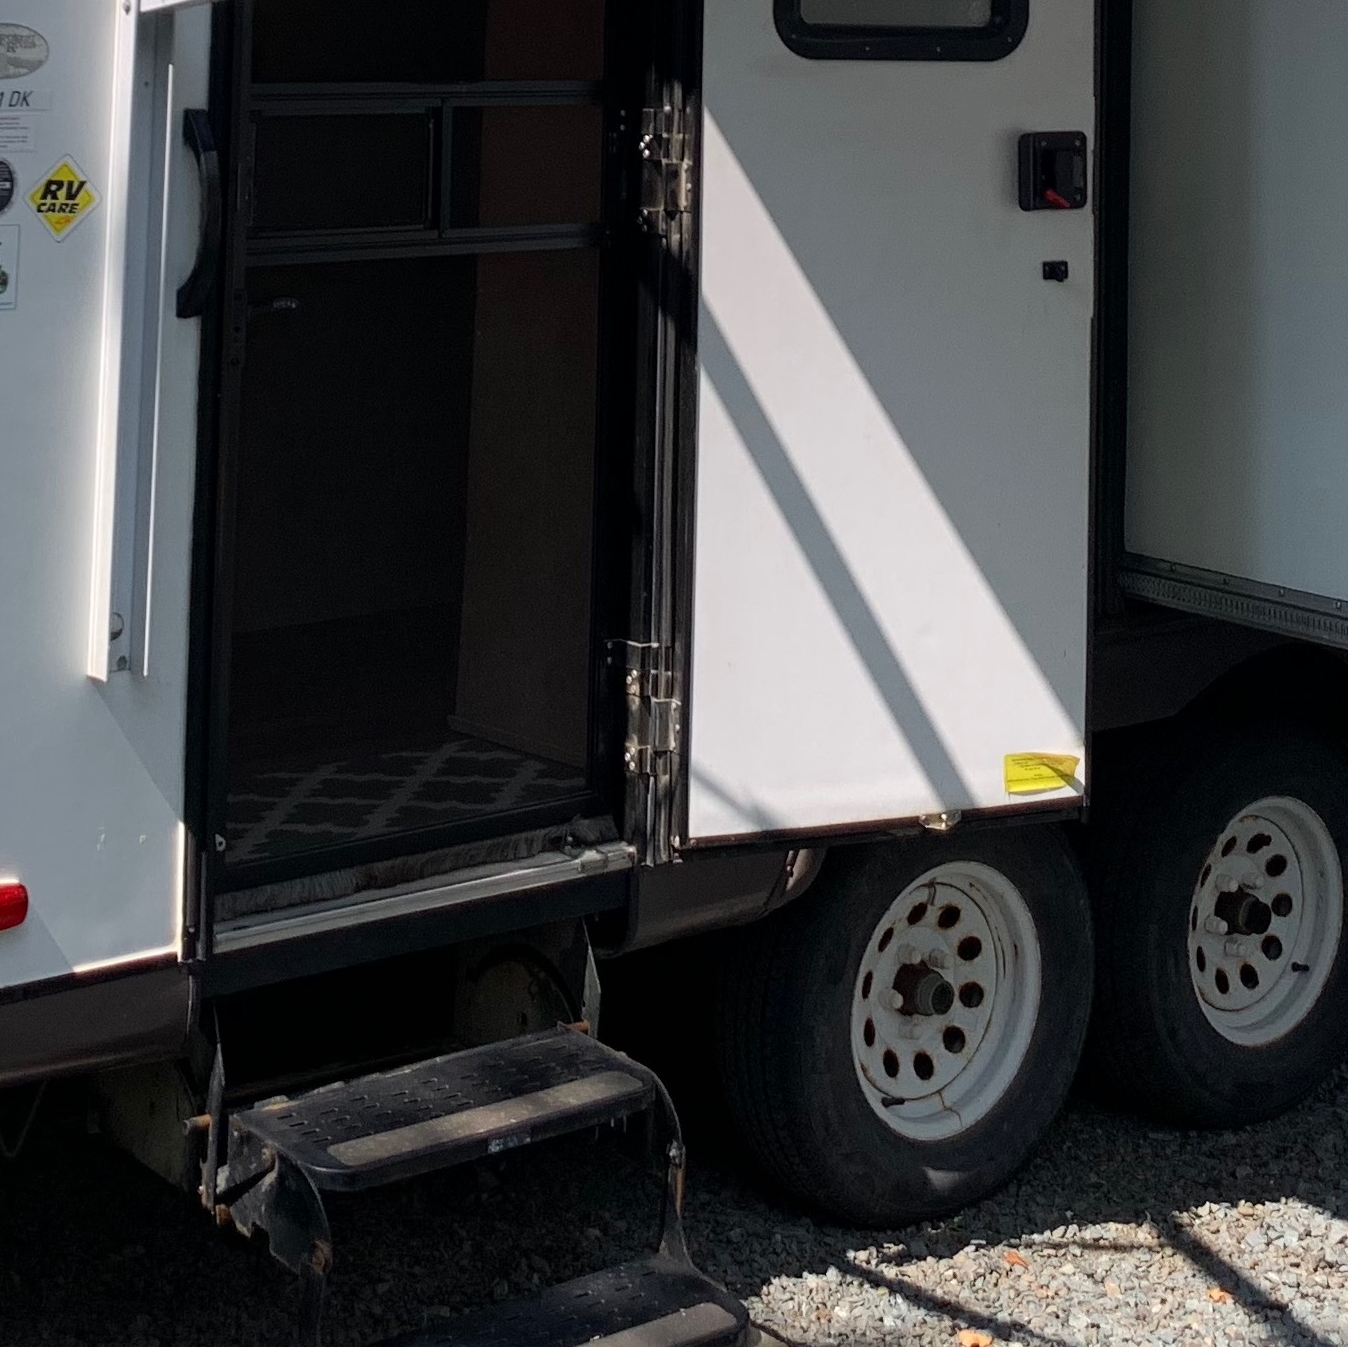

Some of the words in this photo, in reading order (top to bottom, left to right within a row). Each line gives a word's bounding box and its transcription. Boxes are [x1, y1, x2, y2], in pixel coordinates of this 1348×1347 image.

[8, 90, 34, 107] DK
[39, 179, 87, 201] RV
[36, 202, 80, 214] CARE
